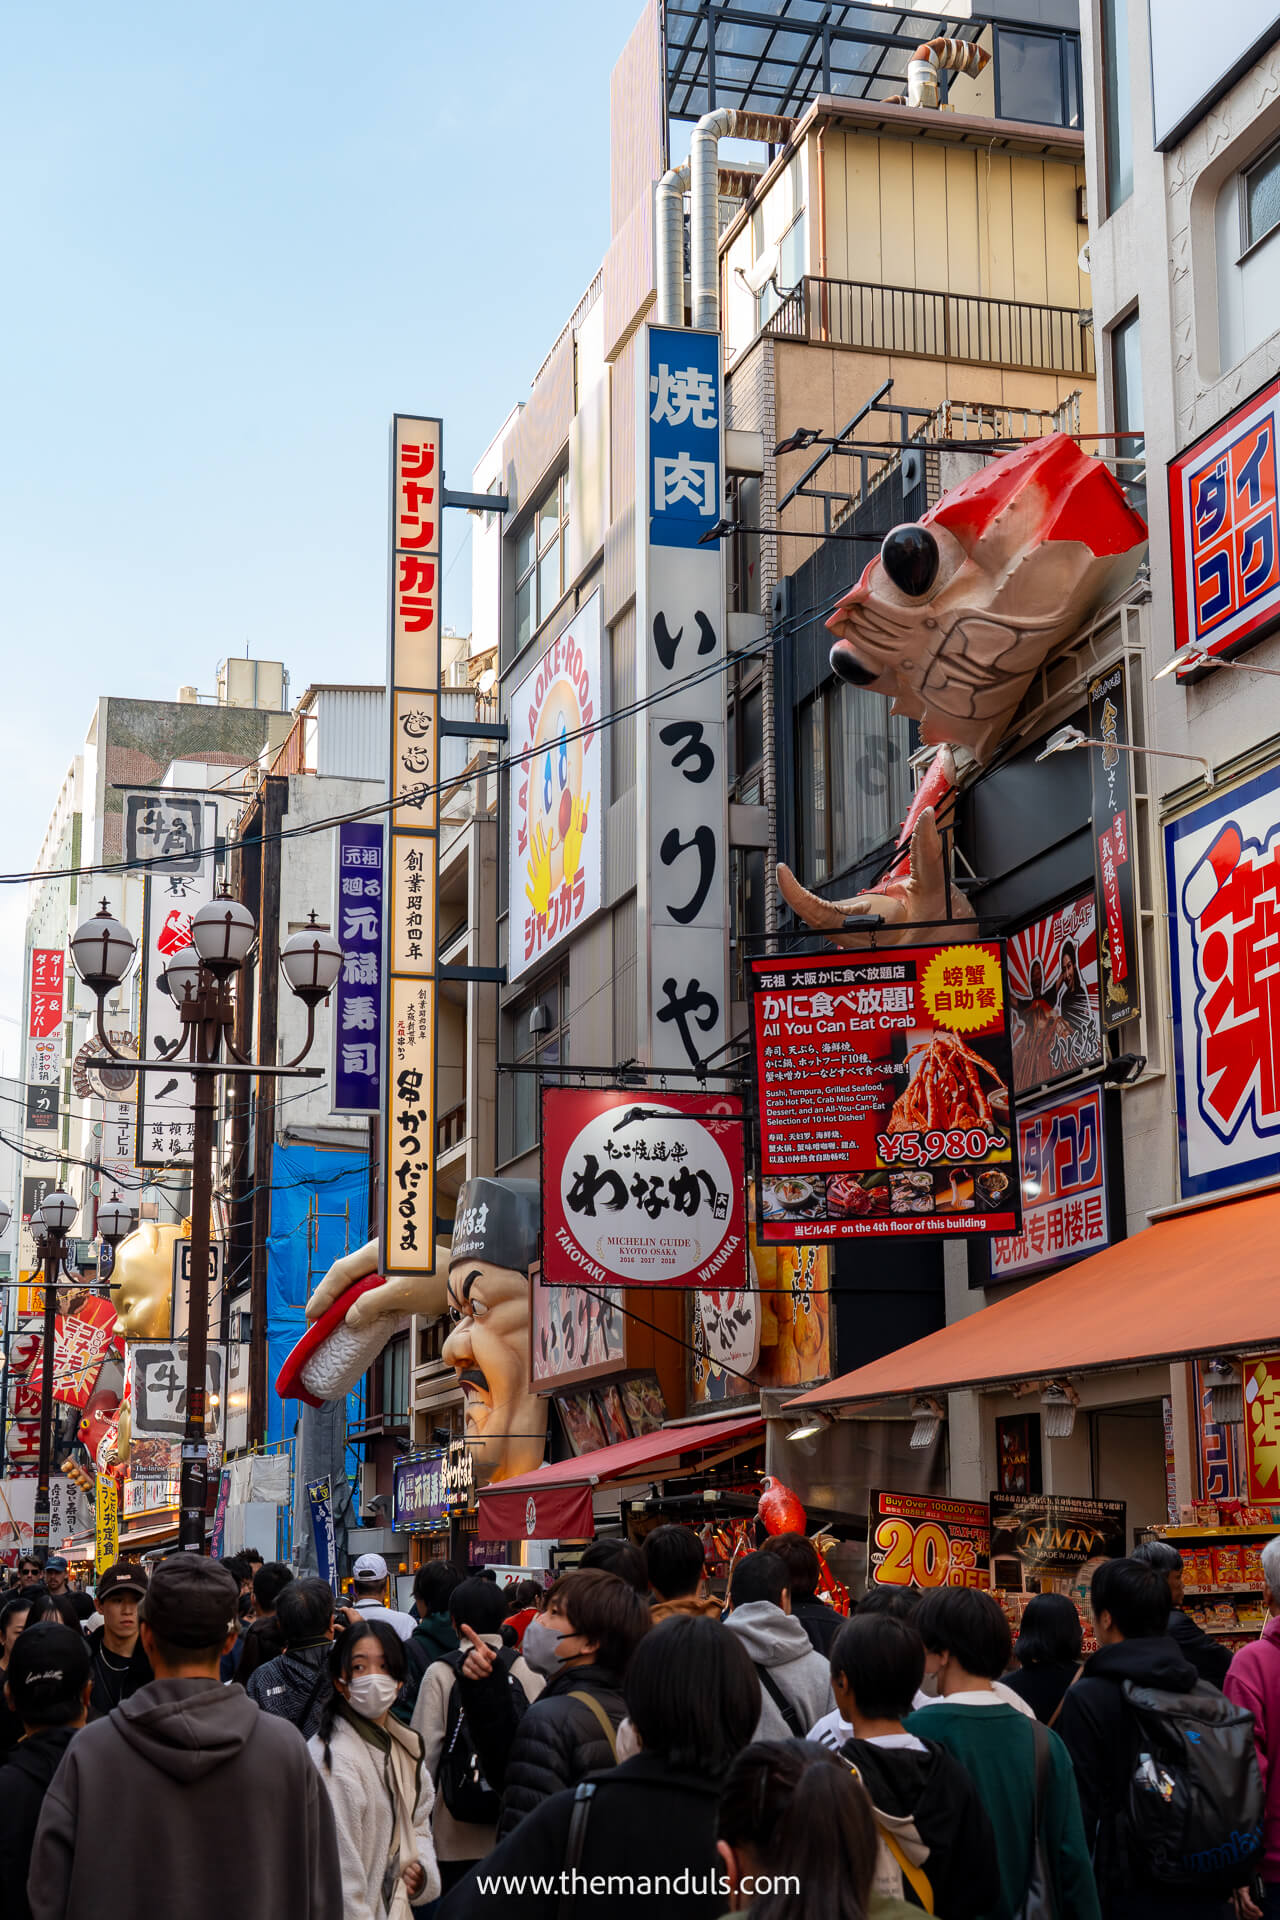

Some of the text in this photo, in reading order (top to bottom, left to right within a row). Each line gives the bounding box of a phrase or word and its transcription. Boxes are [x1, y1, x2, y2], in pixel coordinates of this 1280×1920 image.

[650, 362, 717, 517] 焼肉
[400, 442, 435, 633] ジャンカラ
[651, 608, 719, 1067] いろりや
[404, 848, 426, 961] 創業昭和四年
[760, 966, 905, 988] 元祖 大阪かに食べ放題店
[943, 965, 985, 986] 螃蟹
[342, 906, 379, 1077] 元禄寿司
[934, 988, 996, 1012] 自助餐
[763, 1014, 916, 1037] All You Can Eat Crab
[766, 1083, 885, 1098] Sushi, Tempura, Grilled Seafood,
[766, 1099, 784, 1107] Crab
[785, 1098, 799, 1106] Hot
[817, 1095, 834, 1104] Crab
[836, 1095, 854, 1103] Miso
[856, 1093, 878, 1102] Curry,
[766, 1108, 797, 1117] Dessert,
[799, 1107, 812, 1115] and
[825, 1103, 885, 1114] All-You-Can-Eat
[767, 1117, 801, 1126] Selection
[802, 1116, 811, 1124] of
[838, 1113, 866, 1121] Dishes!
[395, 1067, 428, 1252] 串かつだるま
[567, 1155, 718, 1219] わなか
[795, 1218, 986, 1236] 当ビル4F on the 4th floor of this building
[607, 1237, 691, 1247] MICHELIN GUIDE
[650, 1248, 677, 1256] OSAKA
[554, 1227, 606, 1282] TAKOYAKI
[697, 1235, 741, 1282] WANAKA
[885, 1496, 903, 1507] Buy
[906, 1499, 928, 1508] Over
[931, 1502, 965, 1513] 100,000
[968, 1507, 985, 1516] Yen
[1022, 1527, 1097, 1552] NMN
